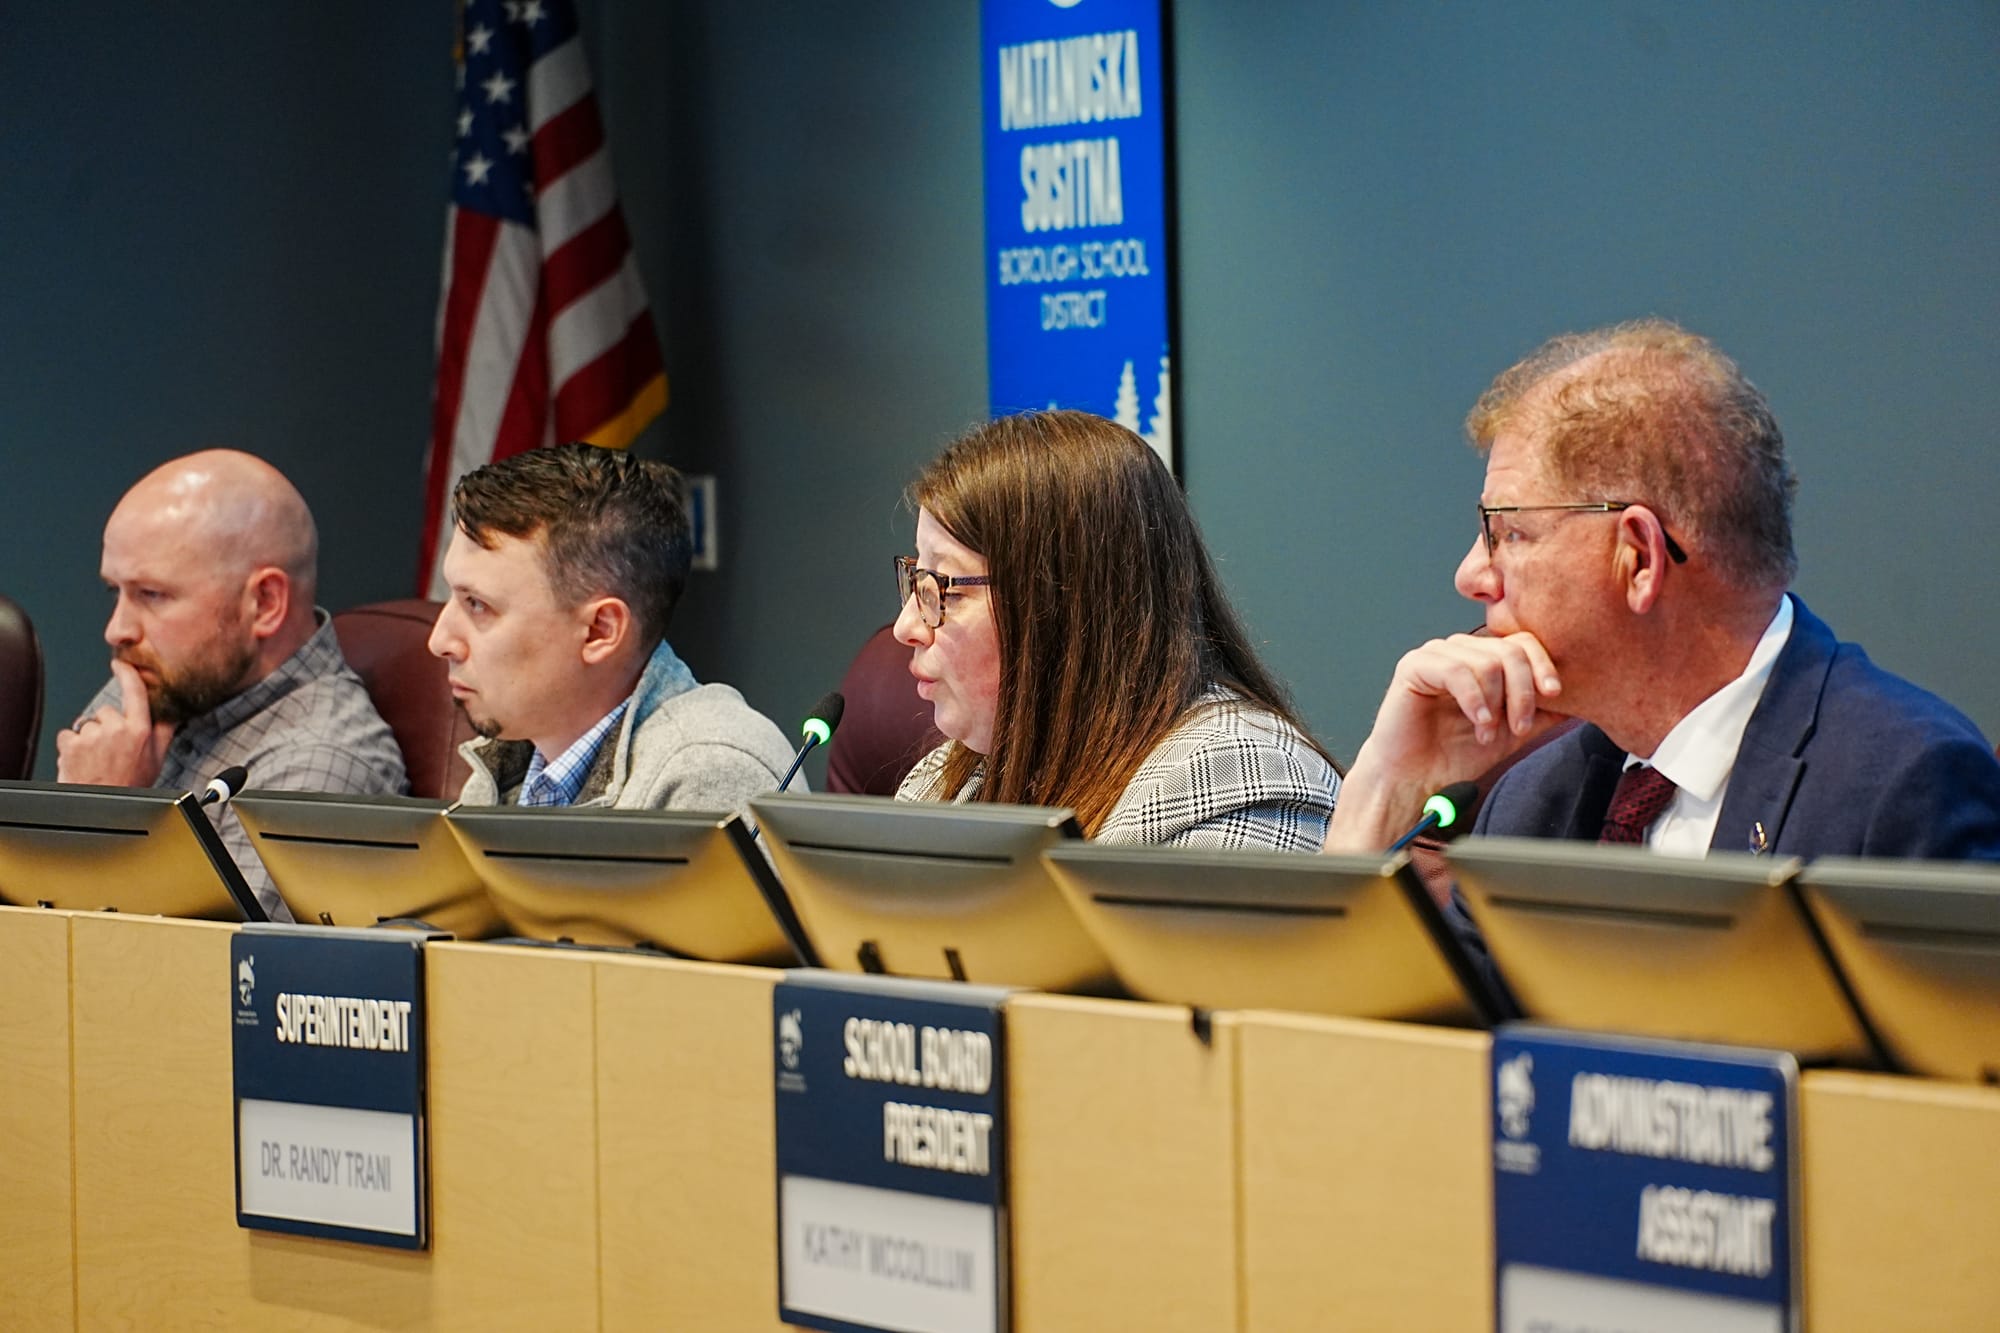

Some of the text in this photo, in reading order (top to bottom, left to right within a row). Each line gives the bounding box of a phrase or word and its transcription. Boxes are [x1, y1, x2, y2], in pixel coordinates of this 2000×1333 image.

[1000, 30, 1142, 132] MATANUSKA
[1020, 137, 1124, 233] SUSITNA
[1000, 238, 1149, 286] BOROUGH SCHOOL
[1041, 290, 1106, 331] DISTRICT
[276, 993, 411, 1052] SUPERINTENDENT
[843, 1016, 993, 1095] SCHOOL BOARD
[261, 1141, 391, 1193] DR. RANDY TRANI
[883, 1101, 993, 1176] PRESIDENT
[1636, 1183, 1775, 1279] ASSISTANT
